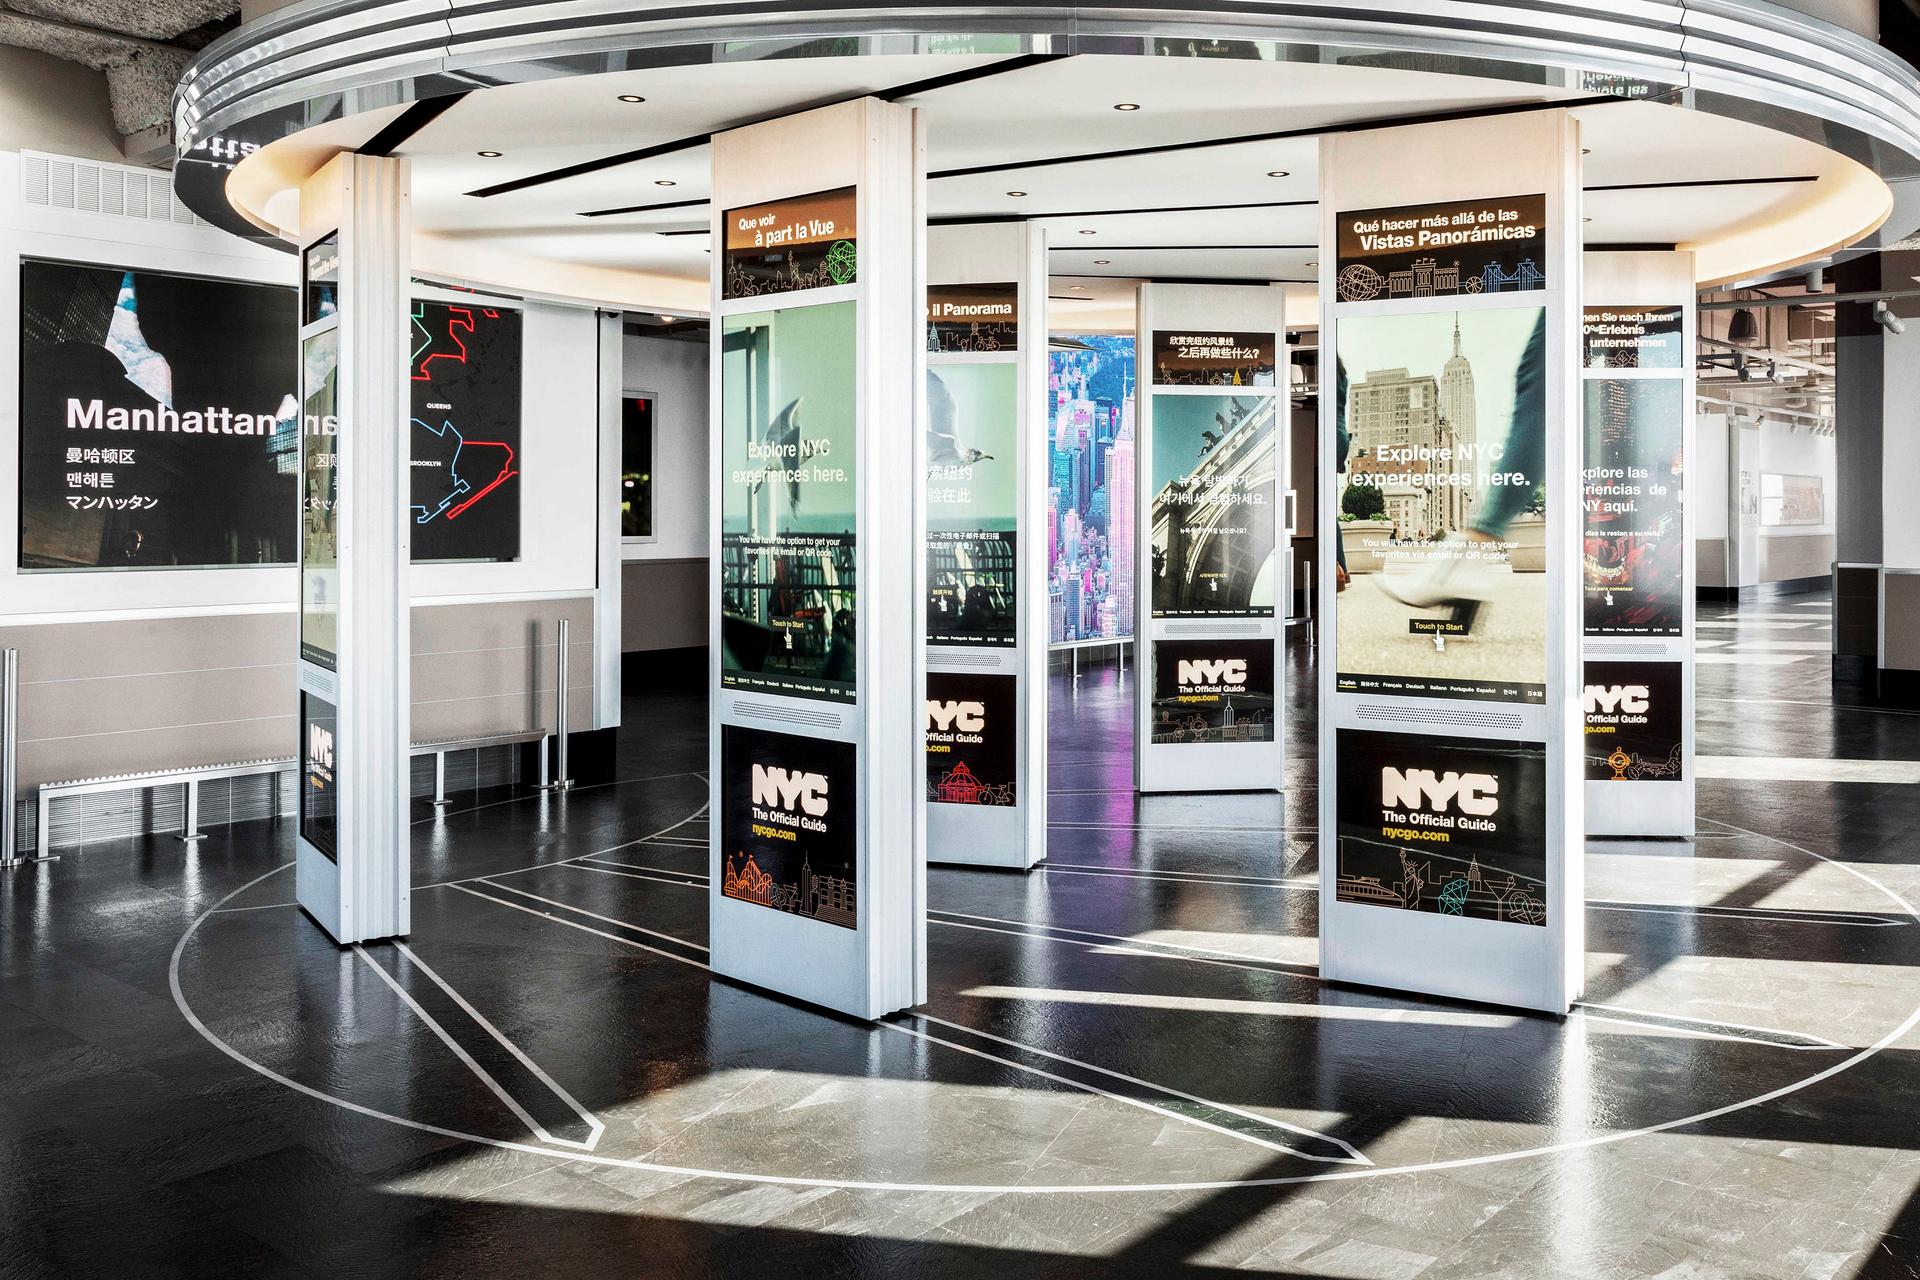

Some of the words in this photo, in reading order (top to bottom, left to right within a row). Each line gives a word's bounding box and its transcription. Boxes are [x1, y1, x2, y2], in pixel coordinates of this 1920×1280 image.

[739, 218, 756, 230] Que
[759, 214, 776, 226] voir
[1354, 219, 1379, 234] Qué
[1382, 219, 1419, 231] hacer
[1422, 215, 1448, 228] más
[1452, 212, 1474, 225] allá
[1478, 211, 1495, 223] de
[1498, 210, 1518, 221] las
[755, 230, 762, 246] à
[766, 227, 792, 248] part
[796, 223, 806, 239] la
[809, 220, 834, 236] Vue
[1361, 234, 1414, 250] Vistas
[1418, 224, 1536, 246] Panorámicas
[932, 304, 940, 316] il
[944, 303, 1012, 316] Panorama
[1602, 313, 1617, 321] Sie
[1620, 313, 1643, 321] nach
[1646, 313, 1673, 321] Ihrem
[1590, 338, 1666, 347] unternehmen
[67, 398, 276, 436] Manhattan
[66, 448, 135, 464] 曼哈顿区
[748, 441, 796, 460] Explore
[800, 439, 830, 456] NYC
[1377, 445, 1452, 464] Explore
[1458, 443, 1503, 460] NYC
[67, 472, 115, 488] 맨해튼
[733, 467, 810, 486] experiences
[814, 465, 848, 482] here.
[929, 465, 972, 480] 索纽约
[1352, 470, 1472, 490] experiences
[1477, 470, 1530, 486] here.
[1583, 467, 1624, 480] xplore
[1628, 467, 1648, 478] las
[928, 488, 971, 503] 验在此
[1649, 484, 1666, 495] de
[66, 496, 158, 510] マンハッタン
[1604, 500, 1638, 514] aquí.
[739, 536, 750, 544] You
[751, 536, 760, 544] will
[761, 536, 775, 544] have
[787, 537, 806, 546] option
[815, 538, 825, 547] get
[826, 539, 840, 547] your
[1363, 539, 1379, 547] You
[1381, 539, 1395, 547] will
[1396, 539, 1418, 547] have
[1420, 539, 1435, 547] the
[1436, 539, 1466, 550] option
[1469, 540, 1478, 548] to
[1480, 541, 1497, 550] get
[1498, 542, 1519, 551] your
[805, 548, 815, 556] QR
[816, 549, 834, 557] code.
[1372, 550, 1409, 559] favorites
[1411, 550, 1425, 559] via
[1427, 550, 1452, 559] email
[1466, 552, 1480, 560] QR
[1415, 622, 1436, 630] Touch
[1178, 659, 1247, 684] NYC
[1195, 685, 1221, 693] Official
[1223, 685, 1245, 693] Guide
[1179, 695, 1218, 703] nycgo.com
[1587, 714, 1618, 723] Official
[1621, 715, 1648, 723] Guide
[1584, 726, 1615, 734] go.com
[956, 734, 983, 743] Guide
[752, 764, 828, 816] NYC
[1382, 766, 1498, 816] NYC
[752, 807, 768, 820] The
[770, 810, 799, 827] Official
[801, 817, 827, 833] Guide
[1382, 810, 1406, 823] The
[1409, 812, 1454, 827] Official
[1458, 817, 1496, 831] Guide
[752, 823, 796, 841] nycgo.com
[1383, 826, 1450, 842] nycgo.com
